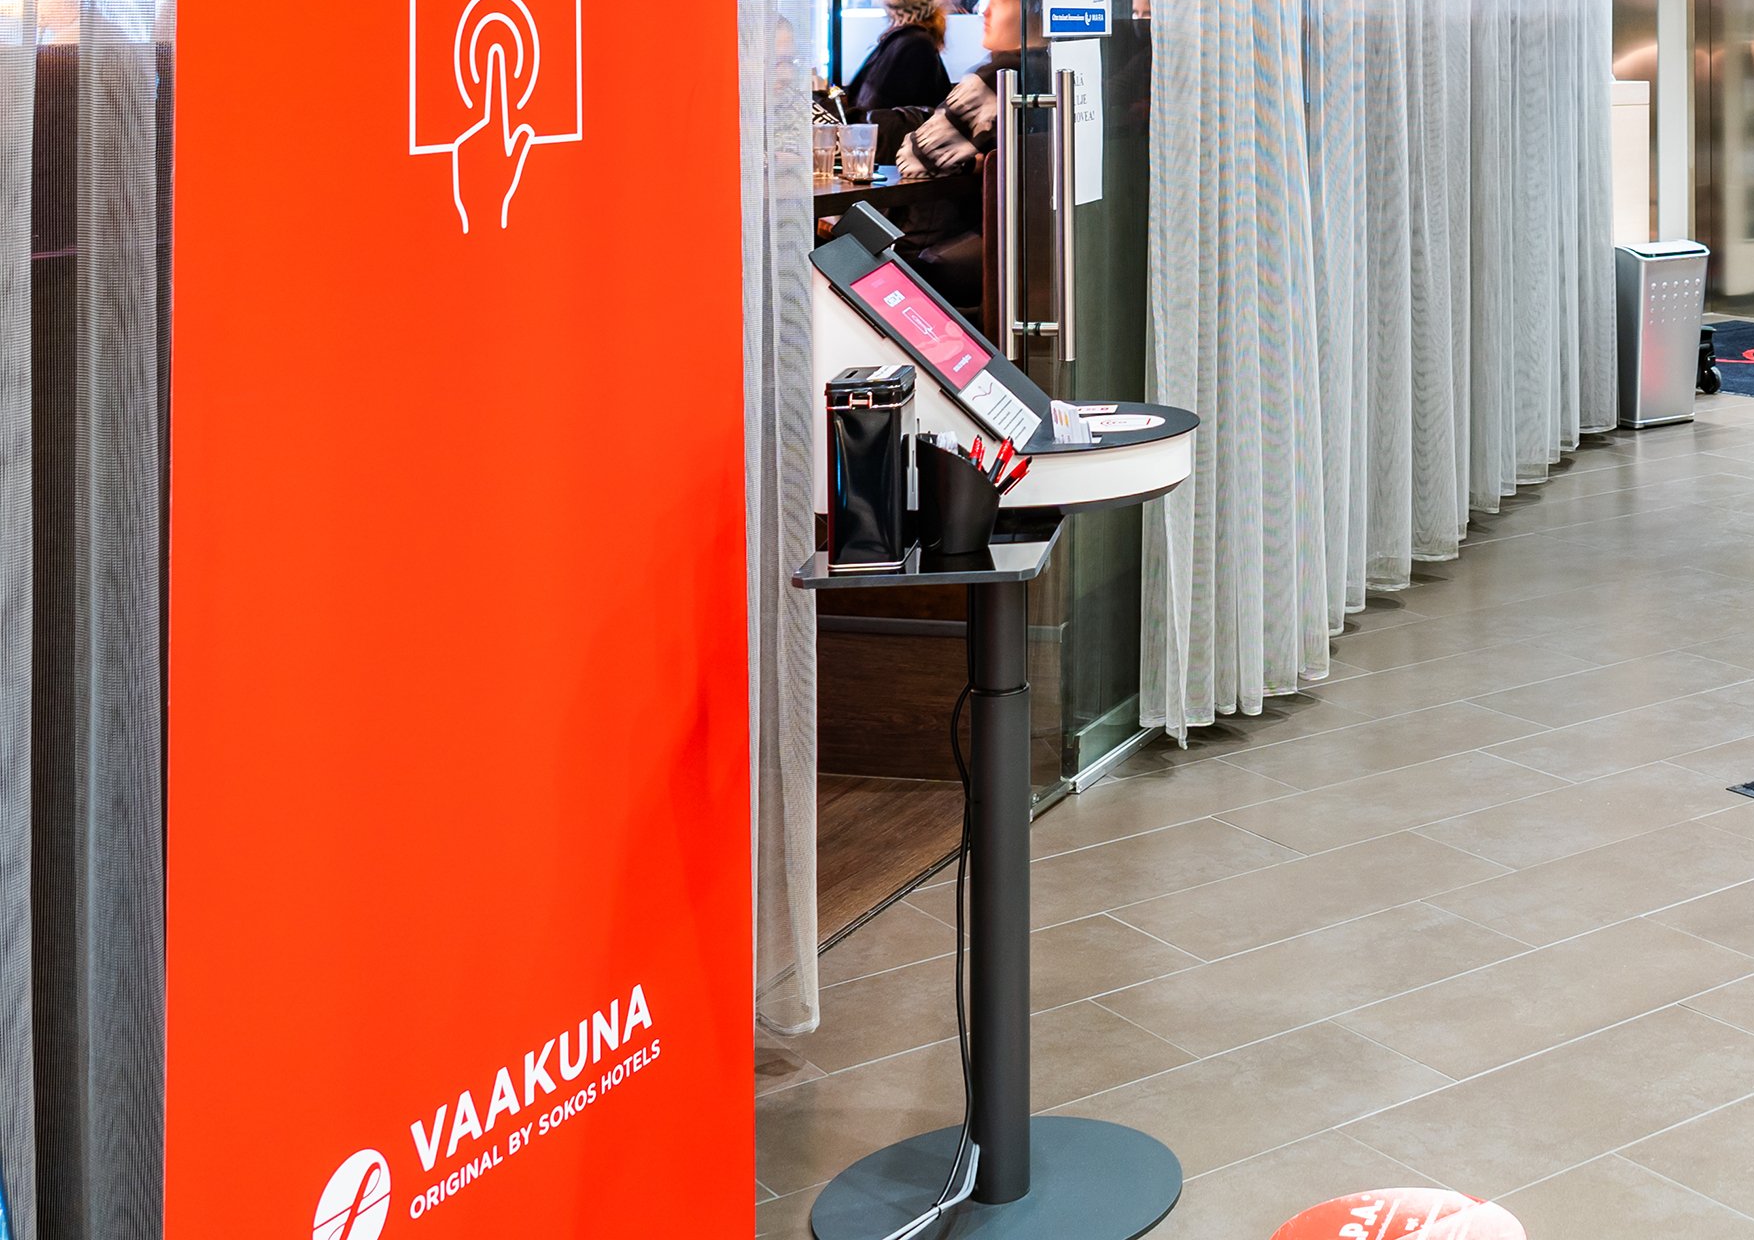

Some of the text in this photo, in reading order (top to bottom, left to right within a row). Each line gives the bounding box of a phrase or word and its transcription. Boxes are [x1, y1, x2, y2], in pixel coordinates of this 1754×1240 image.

[409, 1038, 662, 1220] ORIGINAL BY SOKOS HOTELS
[410, 983, 654, 1173] VAAKUNA
